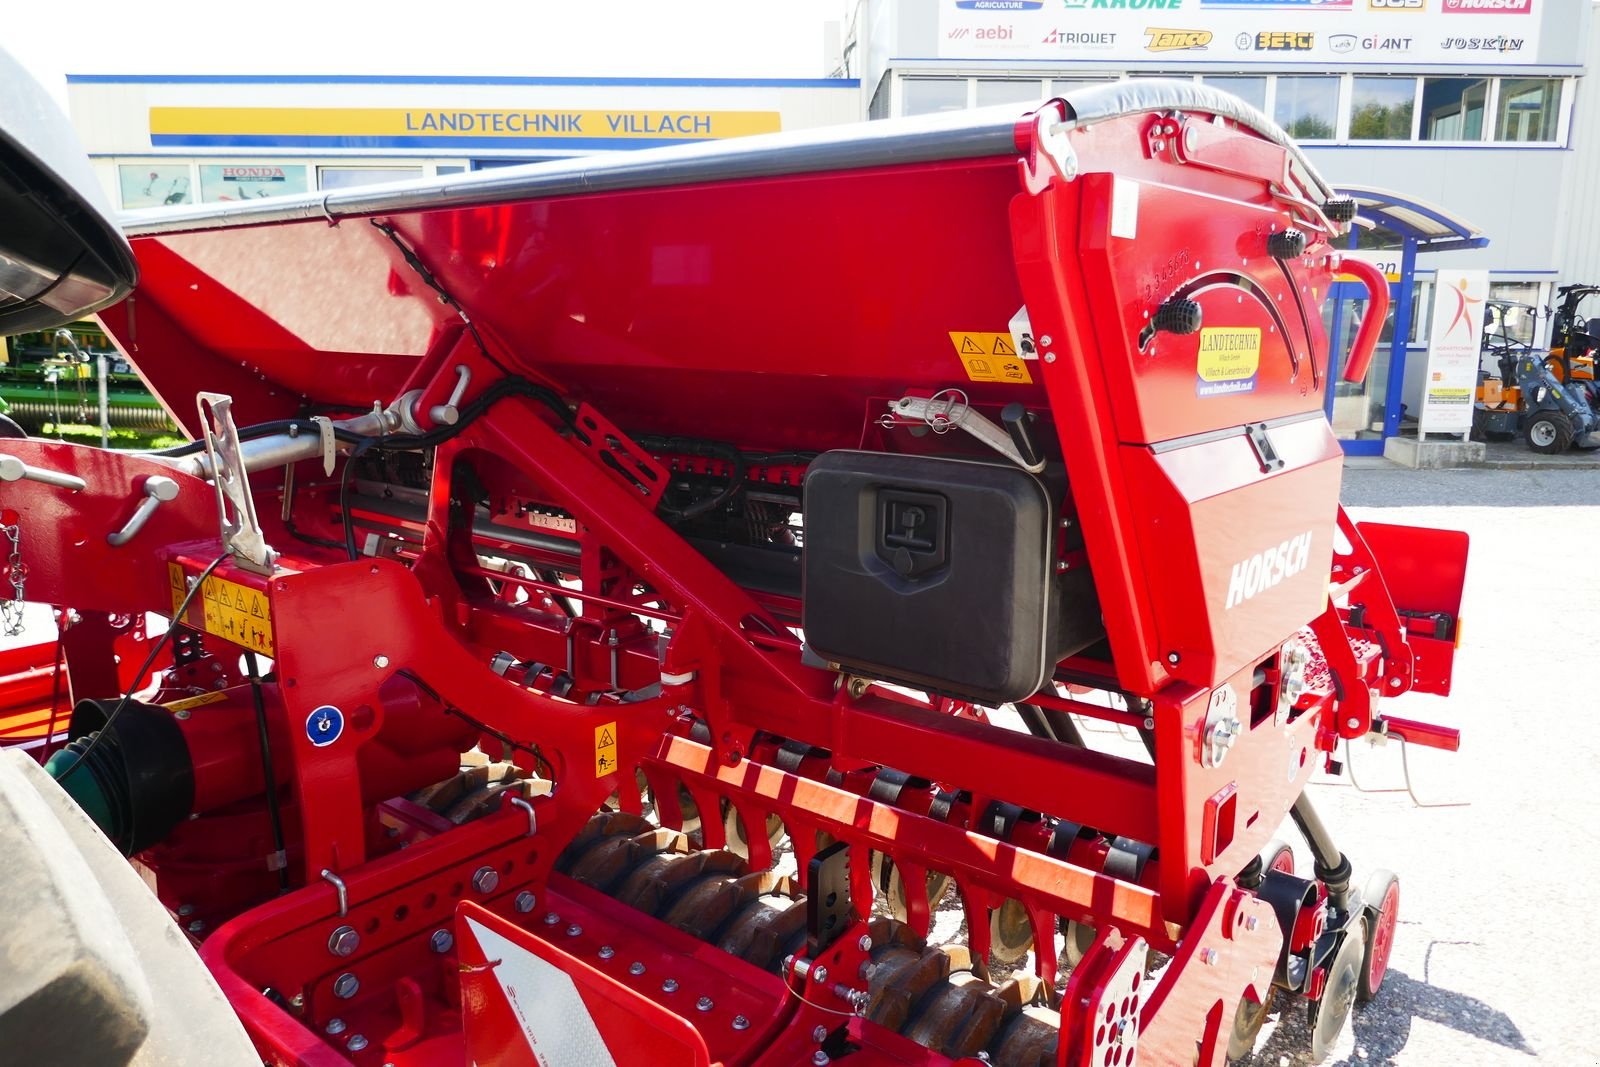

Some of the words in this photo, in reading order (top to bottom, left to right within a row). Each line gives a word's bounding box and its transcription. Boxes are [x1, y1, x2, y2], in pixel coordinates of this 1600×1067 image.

[974, 1, 1023, 9] AGRICULTURE
[975, 25, 1013, 40] aebi
[1059, 32, 1117, 44] TRIOLIET
[1149, 28, 1211, 48] Tanco
[1441, 37, 1524, 50] JOSKIN
[405, 113, 582, 132] LANDTECHNIK
[606, 115, 711, 133] VILLACH
[223, 167, 286, 177] HONDA
[1202, 334, 1258, 352] LANDTECHNIK
[1225, 530, 1313, 610] HORSCH
